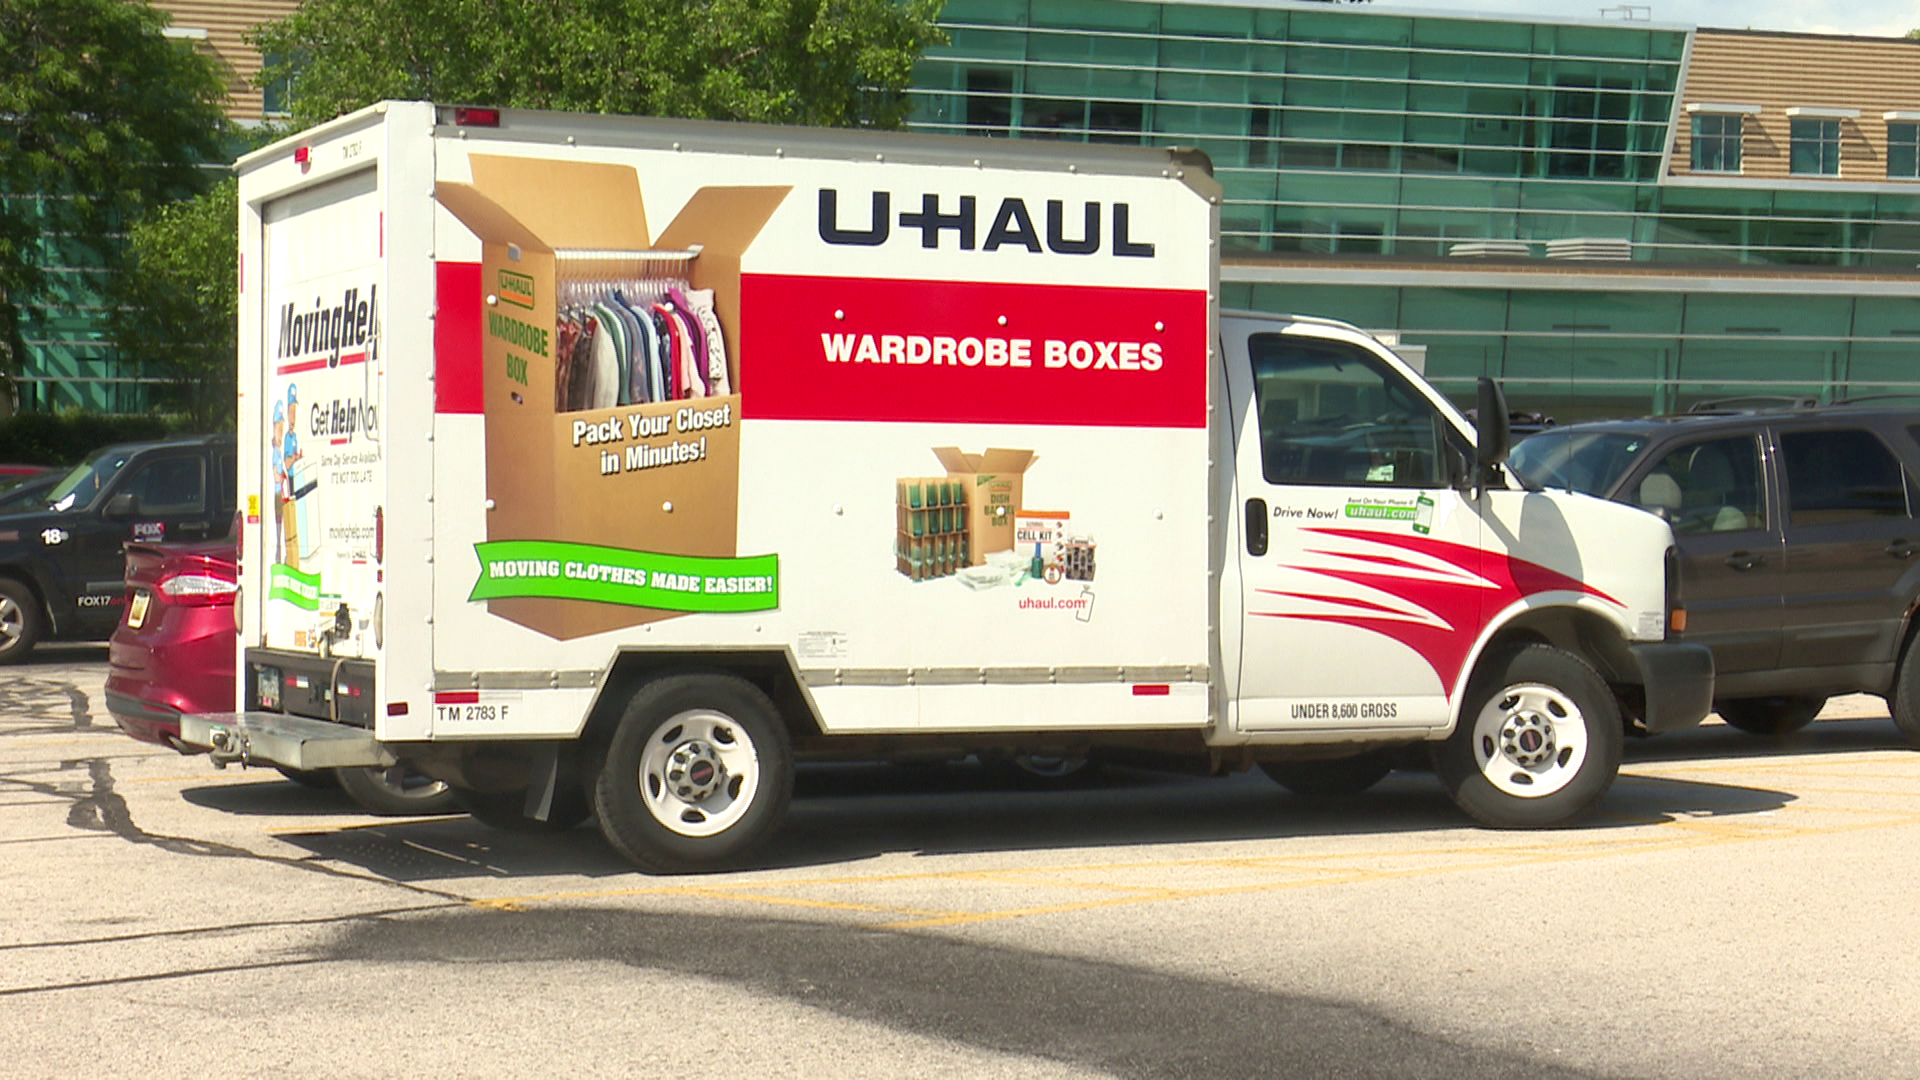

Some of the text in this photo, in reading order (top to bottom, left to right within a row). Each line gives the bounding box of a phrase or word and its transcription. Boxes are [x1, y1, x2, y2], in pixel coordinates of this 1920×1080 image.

[818, 187, 1155, 258] U-HAUL
[501, 274, 532, 297] U-HAUL
[488, 309, 549, 358] WARDROBE
[821, 333, 1163, 371] WARDROBE BOXES
[506, 352, 528, 387] BOX
[310, 402, 330, 437] Get
[331, 398, 357, 443] Help
[572, 404, 731, 446] Pack Your Closet
[600, 436, 707, 476] in Minutes!
[990, 493, 1010, 504] DISH
[984, 504, 1015, 516] BAEL
[1273, 506, 1339, 520] Drive Now!
[1350, 505, 1419, 520] uhaul.com
[134, 523, 162, 536] FOX
[991, 516, 1008, 527] BOX
[41, 529, 62, 545] 18
[1017, 530, 1053, 541] CELL KIT
[489, 560, 773, 593] MOVING CLOTHES MADE EASIER!
[1019, 597, 1088, 609] uhaul.com
[437, 705, 509, 720] TM 2783 F
[1291, 702, 1397, 720] UNDER 8,600 GROSS
